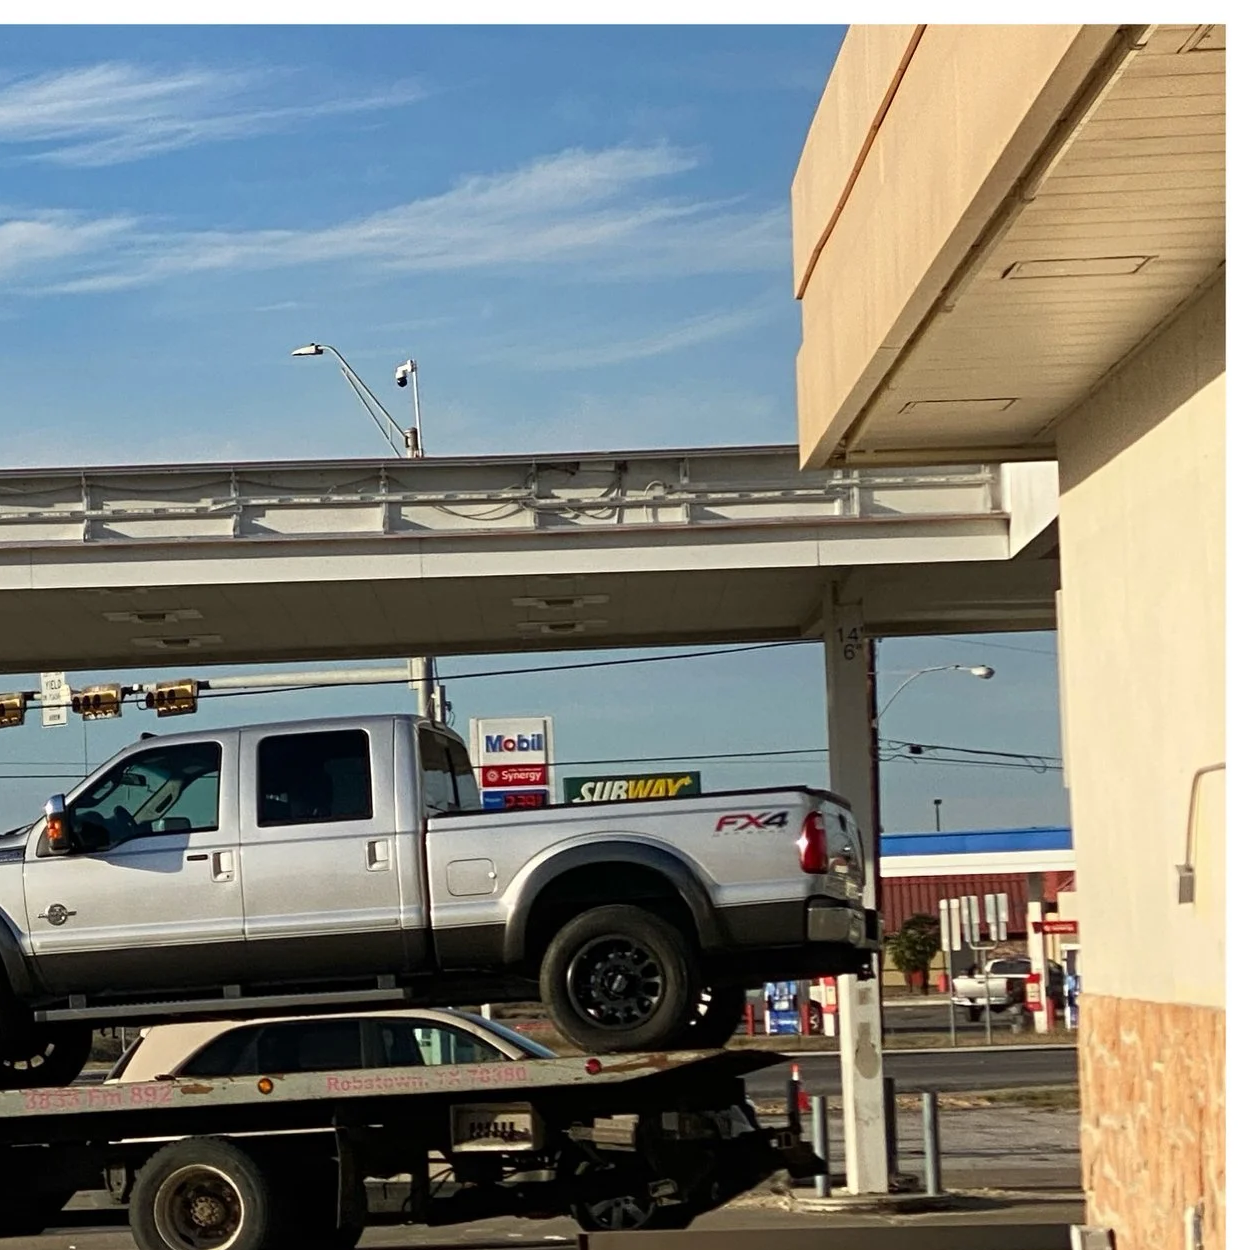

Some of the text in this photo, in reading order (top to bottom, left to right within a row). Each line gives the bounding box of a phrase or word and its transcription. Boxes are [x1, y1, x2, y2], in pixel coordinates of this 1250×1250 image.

[485, 733, 544, 753] Mobil
[501, 770, 542, 782] Synergy
[575, 776, 694, 803] SUBWAY
[715, 811, 790, 832] FX4
[130, 1084, 174, 1105] 892
